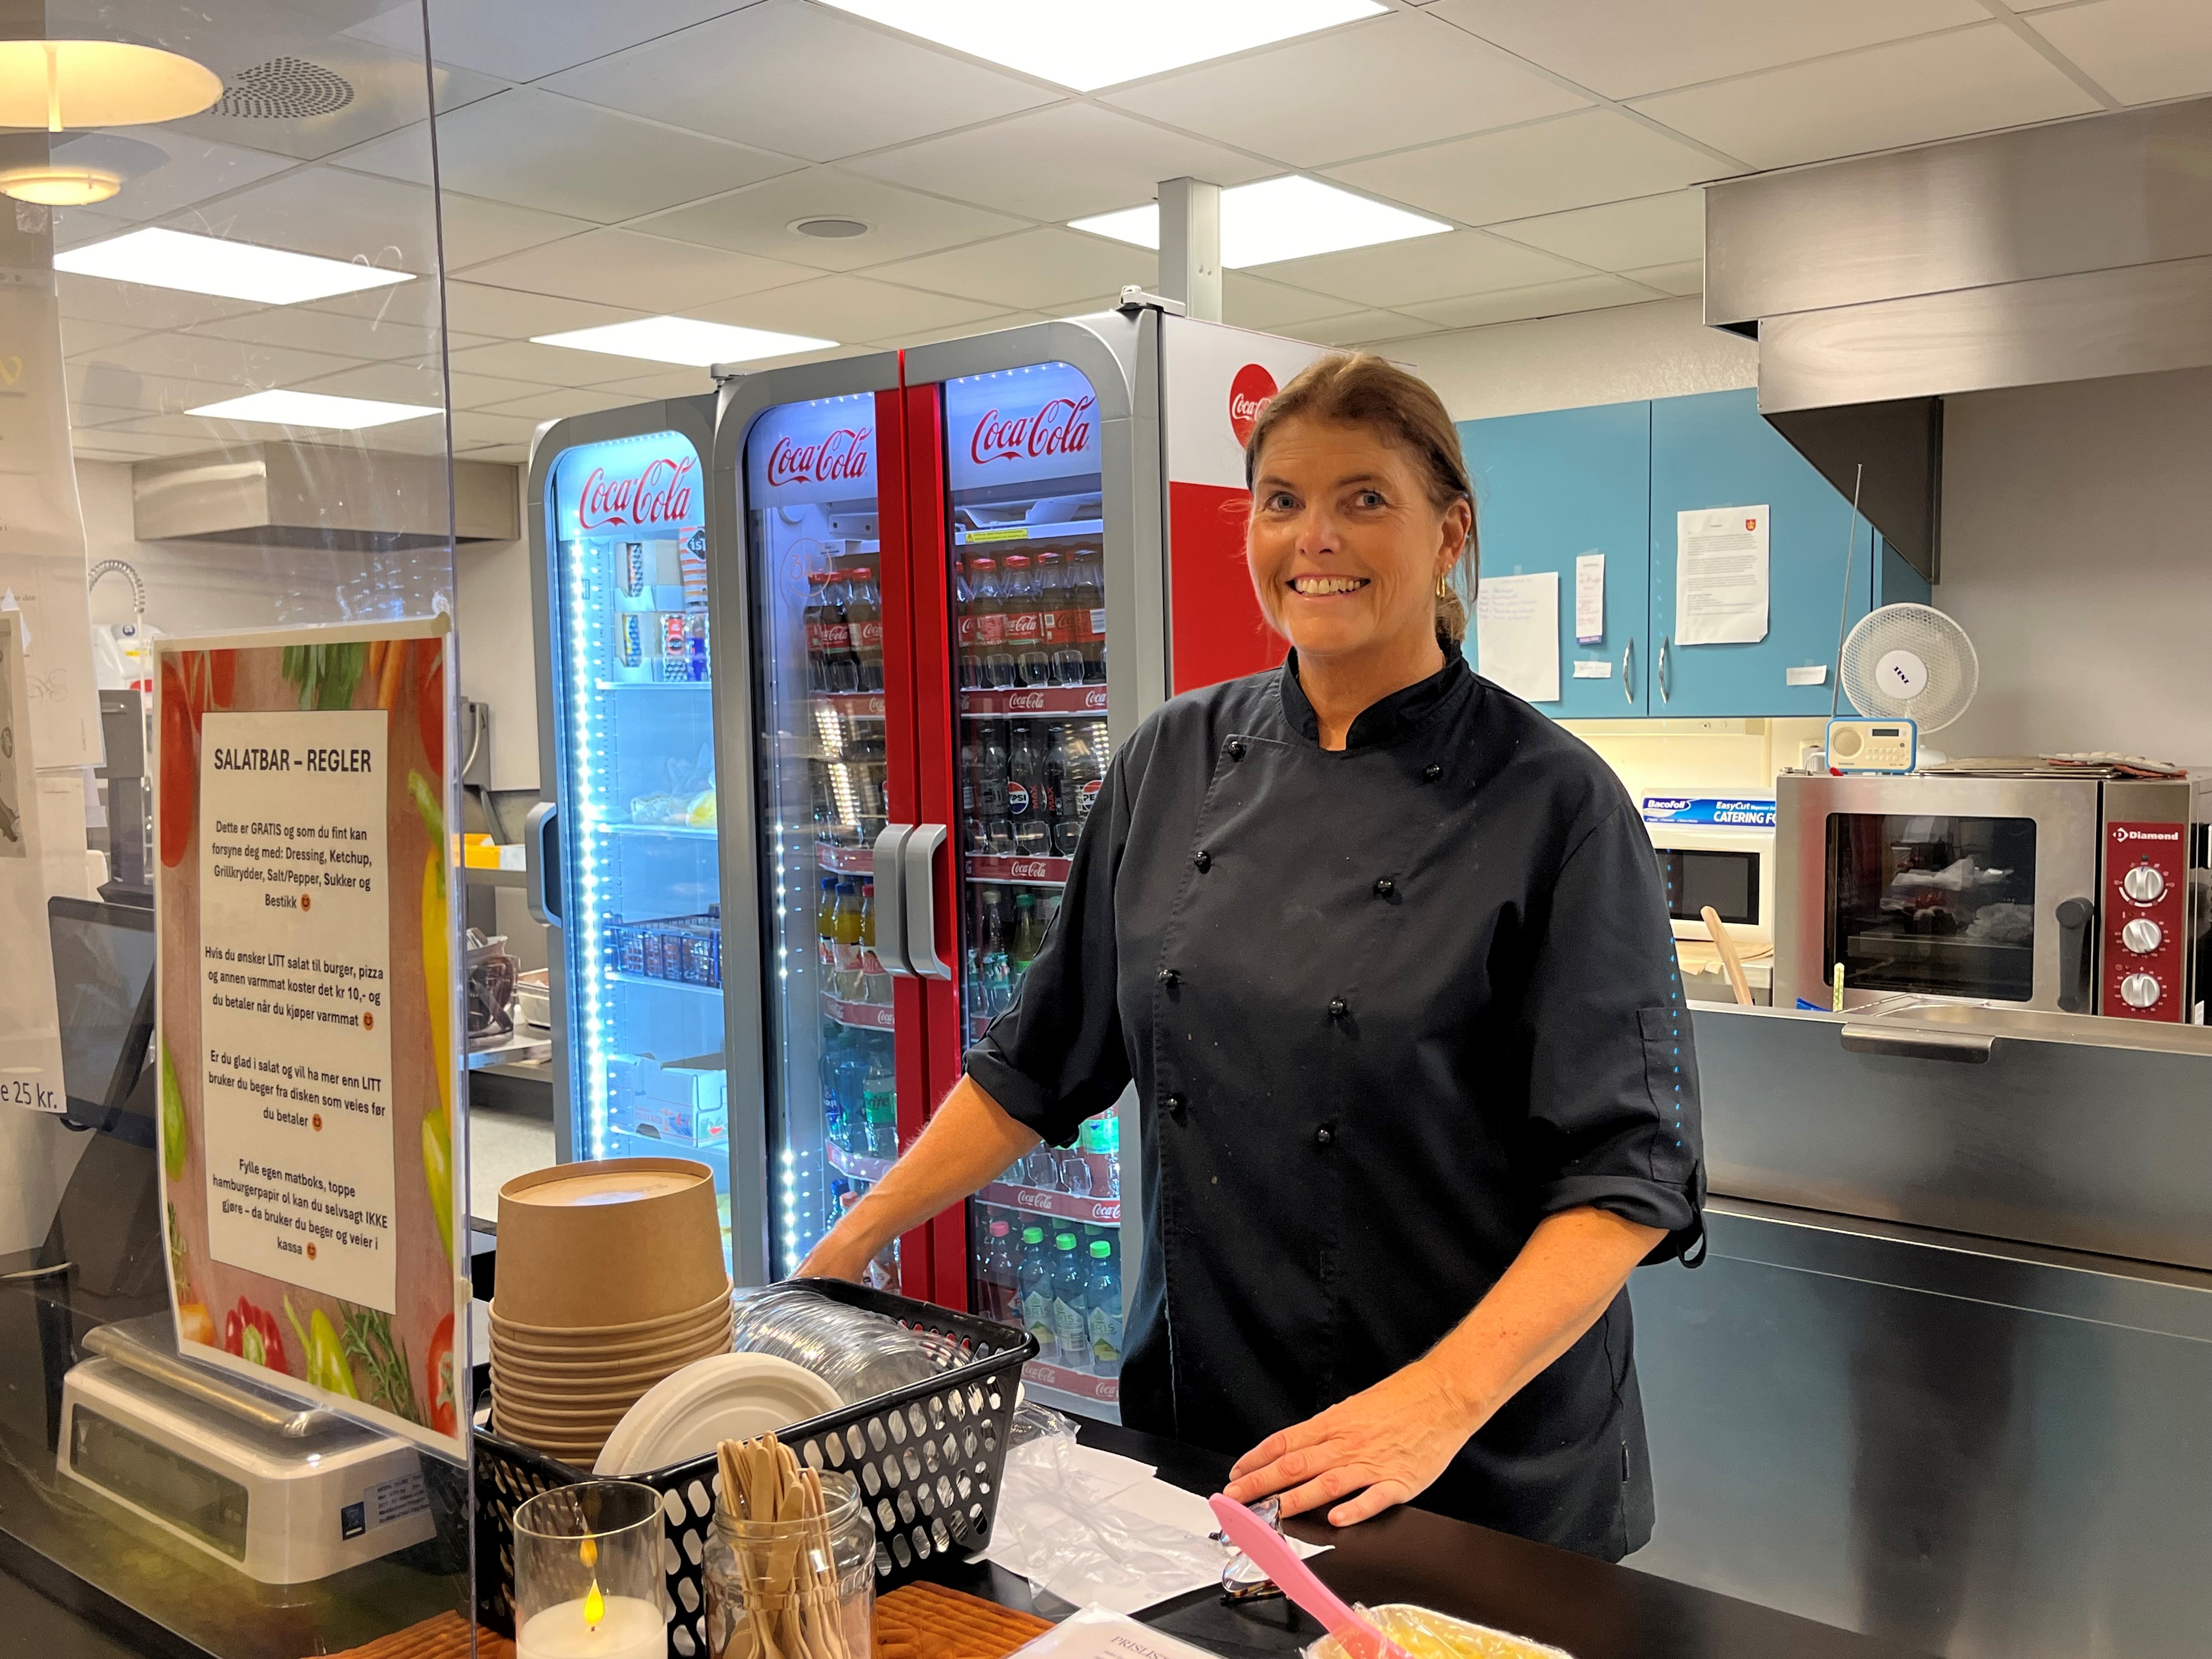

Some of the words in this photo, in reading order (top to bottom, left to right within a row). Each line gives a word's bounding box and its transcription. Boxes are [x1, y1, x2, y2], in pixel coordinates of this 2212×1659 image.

[971, 396, 1096, 465] Coca-Cola
[768, 427, 872, 487] Coca-Cola
[579, 456, 697, 529] Coca-Cola
[1009, 692, 1045, 709] Coca-Cola
[215, 748, 290, 771] SALATBAR
[307, 749, 371, 772] REGLER
[1713, 811, 1764, 824] CATERING
[1716, 802, 1751, 811] EasyCut
[216, 821, 238, 833] Dette
[240, 823, 248, 834] er
[251, 823, 281, 836] GRATIS
[284, 827, 294, 839] og
[296, 828, 315, 838] som
[318, 826, 329, 838] du
[332, 827, 347, 839] fint
[350, 828, 366, 840] kan
[2129, 831, 2179, 840] Diamond
[212, 843, 242, 857] forsyne
[245, 845, 259, 860] deg
[262, 847, 283, 859] med:
[286, 848, 327, 865] Dressing,
[330, 850, 372, 867] Ketchup,
[215, 865, 264, 882] Grillkrydder,
[268, 869, 321, 887] Salt/Pepper,
[324, 873, 356, 888] Sukker
[359, 878, 371, 891] og
[1011, 861, 1046, 877] Coca-Cola
[266, 894, 297, 909] Bestikk
[205, 946, 223, 959] Hvis
[225, 949, 235, 961] du
[238, 952, 266, 964] ønsker
[268, 955, 285, 967] LITT
[287, 957, 309, 970] salat
[312, 960, 321, 972] til
[324, 961, 356, 978] burger,
[359, 965, 383, 980] pizza
[208, 971, 218, 983] og
[220, 972, 245, 985] annen
[248, 976, 285, 990] varmmat
[287, 979, 315, 994] koster
[318, 983, 333, 997] det
[336, 985, 345, 998] kr
[348, 988, 366, 1003] 10,-
[369, 994, 381, 1006] og
[213, 994, 223, 1006] du
[225, 995, 255, 1011] betaler
[257, 999, 270, 1013] når
[273, 1003, 284, 1015] du
[286, 1005, 314, 1020] kjøper
[317, 1011, 359, 1026] varmmat
[211, 1050, 219, 1062] Er
[222, 1053, 232, 1064] du
[234, 1055, 251, 1069] glad
[253, 1058, 256, 1069] i
[259, 1059, 280, 1074] salat
[282, 1065, 292, 1079] og
[295, 1066, 305, 1078] vil
[308, 1068, 319, 1081] ha
[321, 1073, 339, 1085] mer
[342, 1076, 359, 1088] enn
[363, 1076, 381, 1092] LITT
[13, 1081, 31, 1105] 25
[37, 1082, 57, 1109] kr.
[209, 1071, 234, 1087] bruker
[238, 1077, 247, 1090] du
[250, 1080, 273, 1096] beger
[276, 1085, 288, 1098] fra
[291, 1087, 319, 1104] disken
[323, 1096, 342, 1108] som
[345, 1098, 369, 1113] veies
[372, 1102, 385, 1116] før
[263, 1107, 274, 1120] du
[277, 1109, 308, 1126] betaler
[240, 1159, 259, 1174] Fylle
[262, 1165, 282, 1180] egen
[285, 1173, 326, 1193] matboks,
[329, 1181, 356, 1198] toppe
[213, 1175, 279, 1202] hamburgerpapir
[282, 1192, 290, 1204] ol
[293, 1193, 308, 1209] kan
[312, 1199, 322, 1212] du
[325, 1202, 363, 1224] selvsagt
[366, 1211, 387, 1228] IKKE
[1018, 1190, 1052, 1209] Coca-Cola
[222, 1199, 242, 1214] gjøre
[252, 1206, 262, 1220] da
[264, 1209, 292, 1227] bruker
[295, 1217, 306, 1231] du
[309, 1220, 333, 1239] beger
[336, 1231, 347, 1245] og
[349, 1233, 373, 1248] veier
[375, 1238, 378, 1250] i
[277, 1237, 302, 1255] kassa
[1057, 1314, 1074, 1323] RIS
[1090, 1322, 1115, 1333] BRIS
